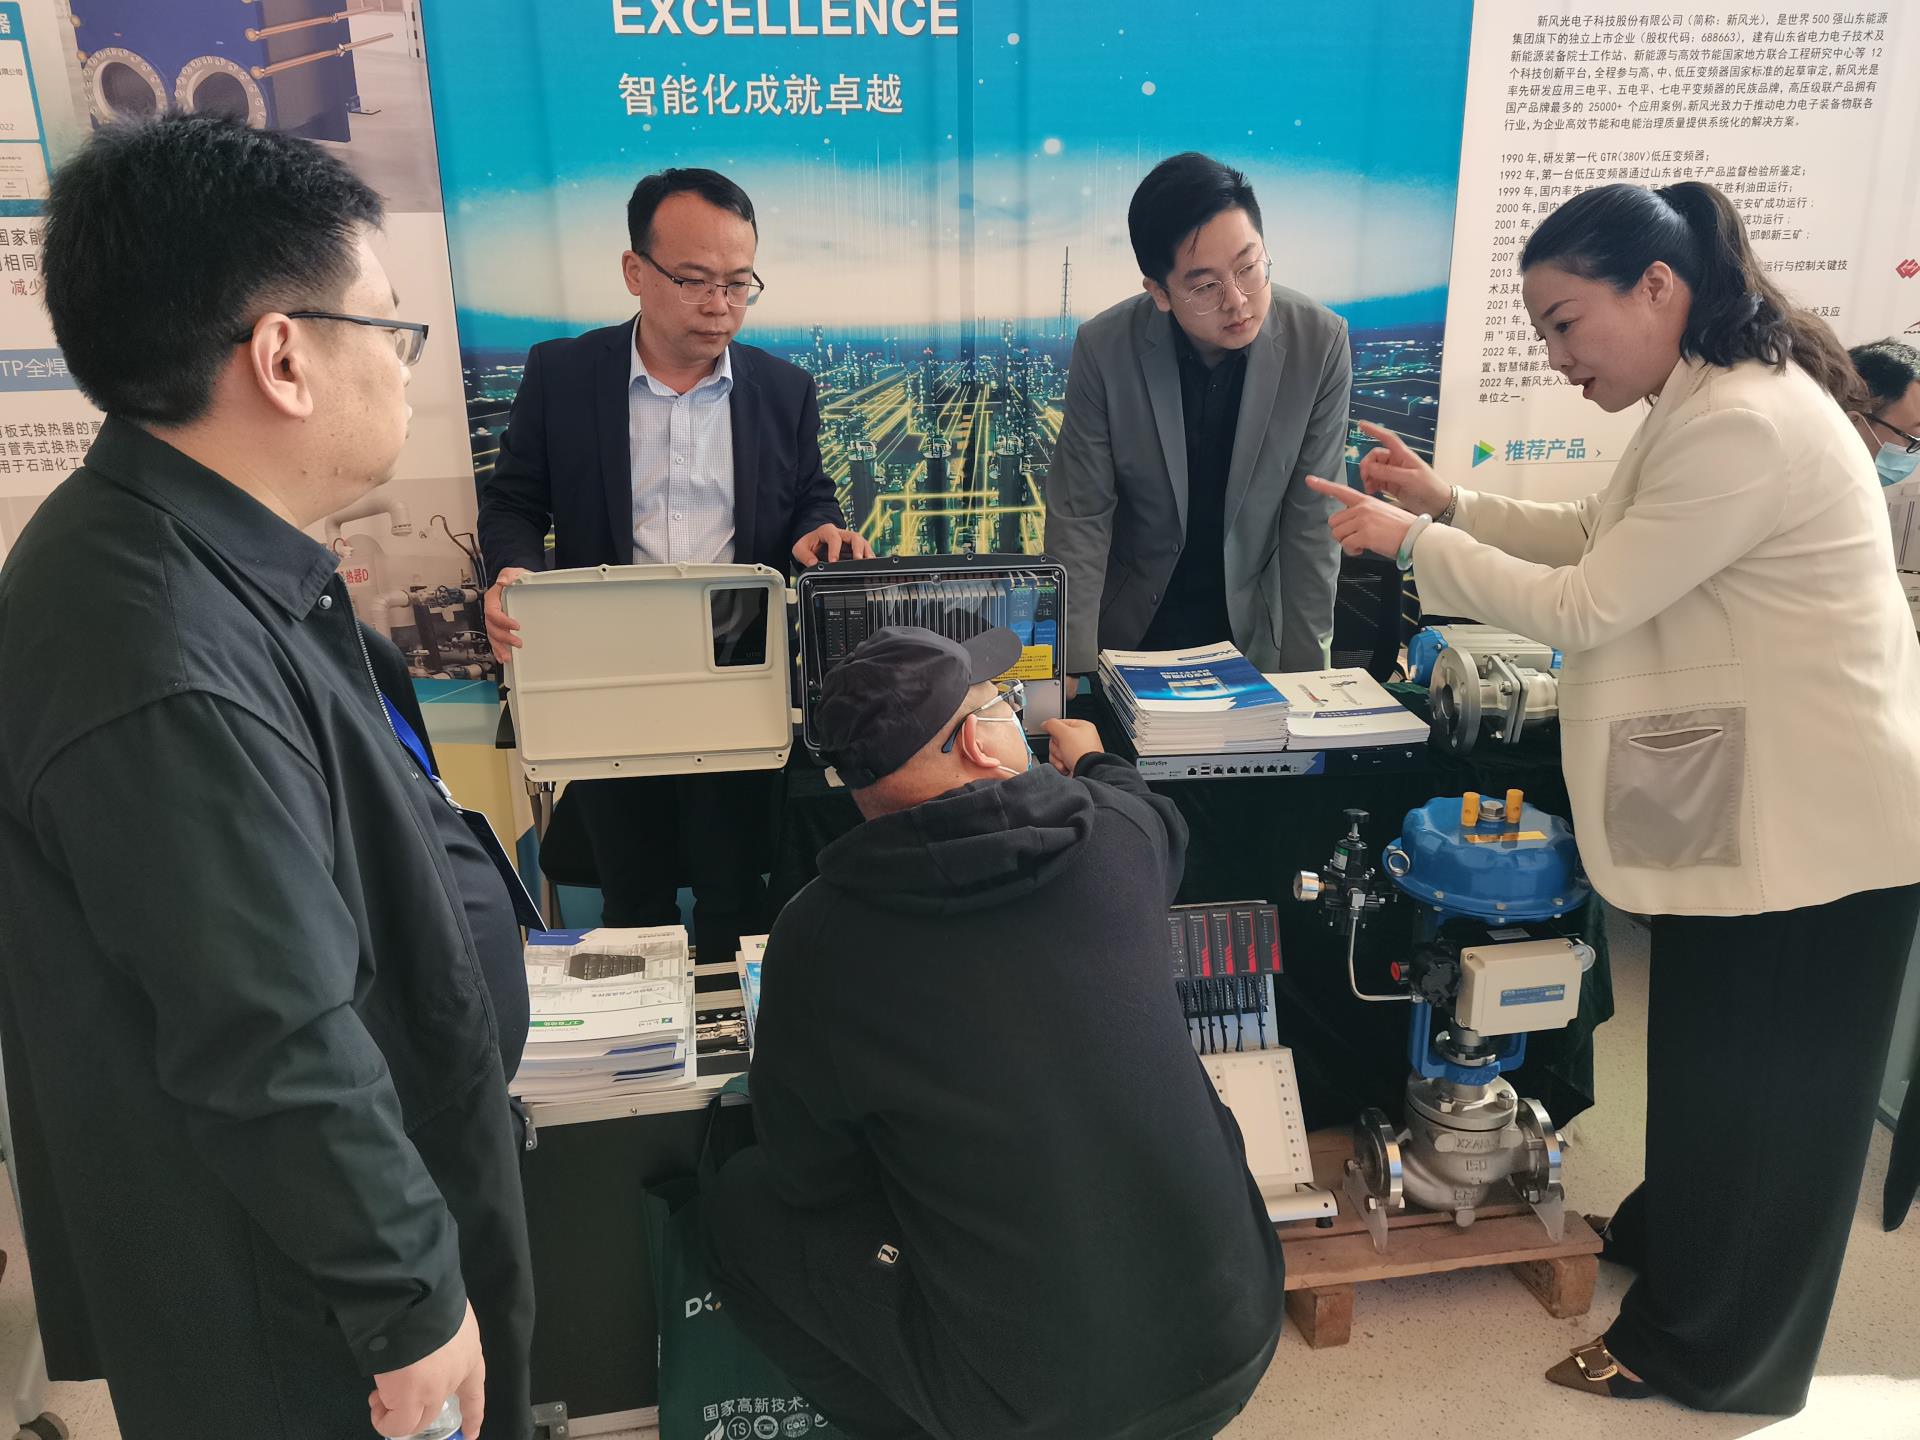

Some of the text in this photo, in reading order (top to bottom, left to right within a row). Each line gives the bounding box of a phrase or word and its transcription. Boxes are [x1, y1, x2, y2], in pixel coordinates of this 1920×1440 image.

[612, 0, 959, 36] EXCELLENCE
[618, 73, 904, 115] 智能化成就卓越
[1491, 252, 1513, 262] 2007
[1490, 269, 1512, 278] 2013
[0, 421, 101, 438] 板式换热器的高
[1504, 438, 1586, 461] 推荐产品
[703, 1396, 809, 1422] 国家高新技术
